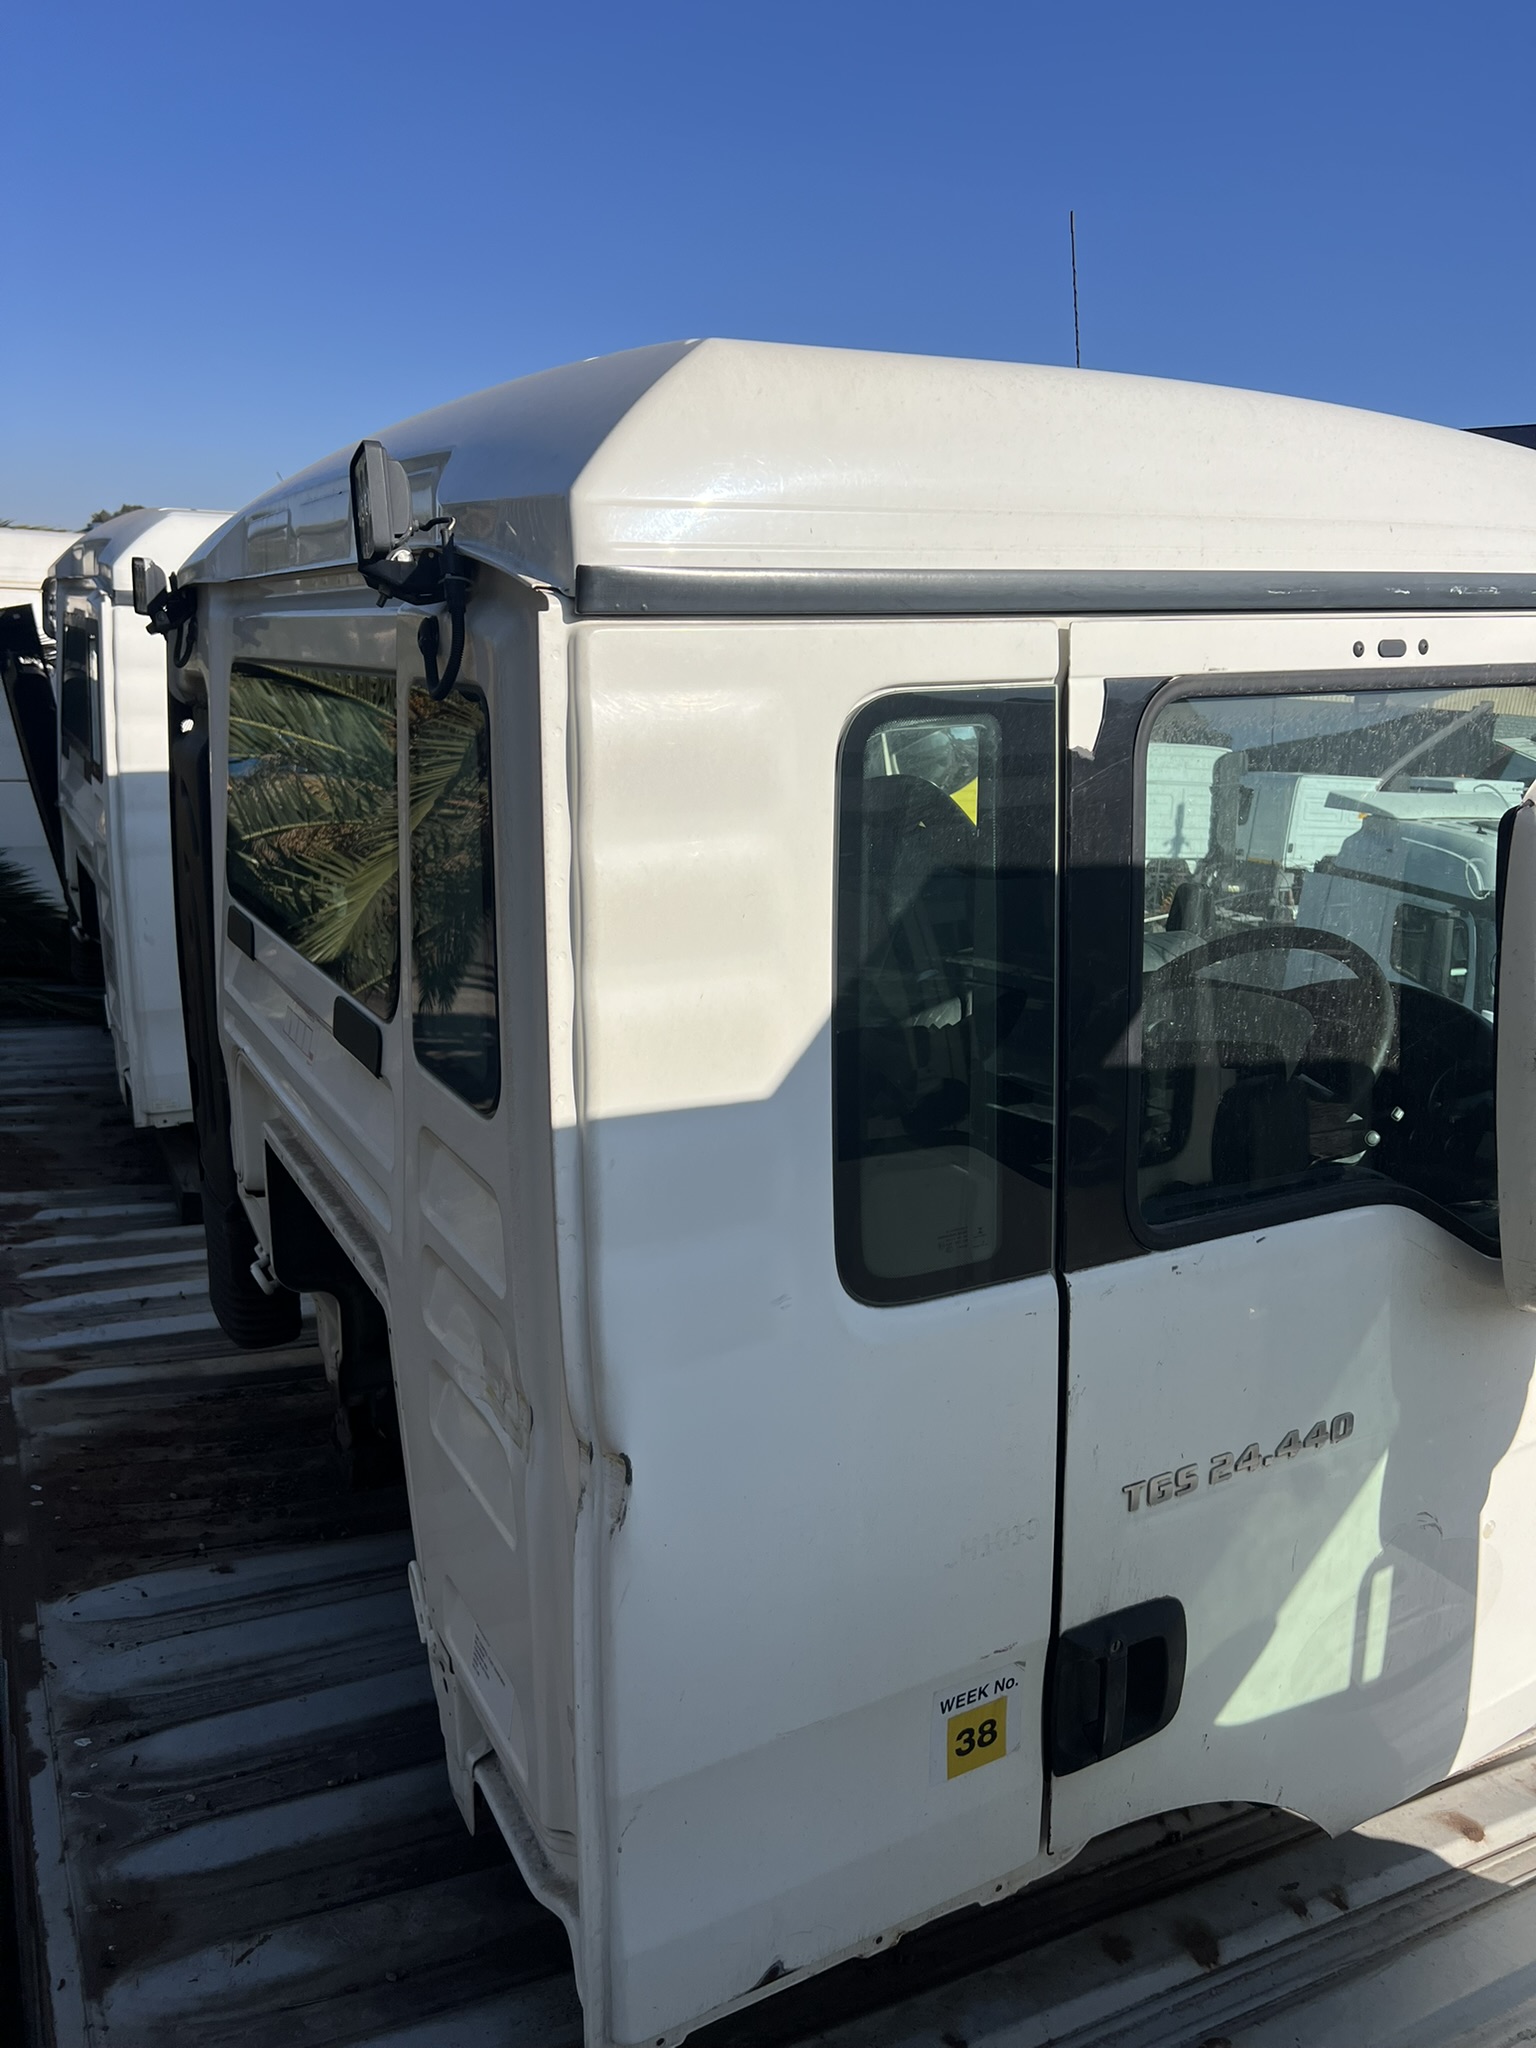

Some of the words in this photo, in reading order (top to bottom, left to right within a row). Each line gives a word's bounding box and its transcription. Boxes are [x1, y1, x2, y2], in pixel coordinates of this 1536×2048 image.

[1121, 1462, 1199, 1513] TGS
[1208, 1411, 1355, 1485] 24.440
[940, 1683, 990, 1715] WEEK
[994, 1677, 1019, 1695] No.
[955, 1718, 998, 1757] 38
